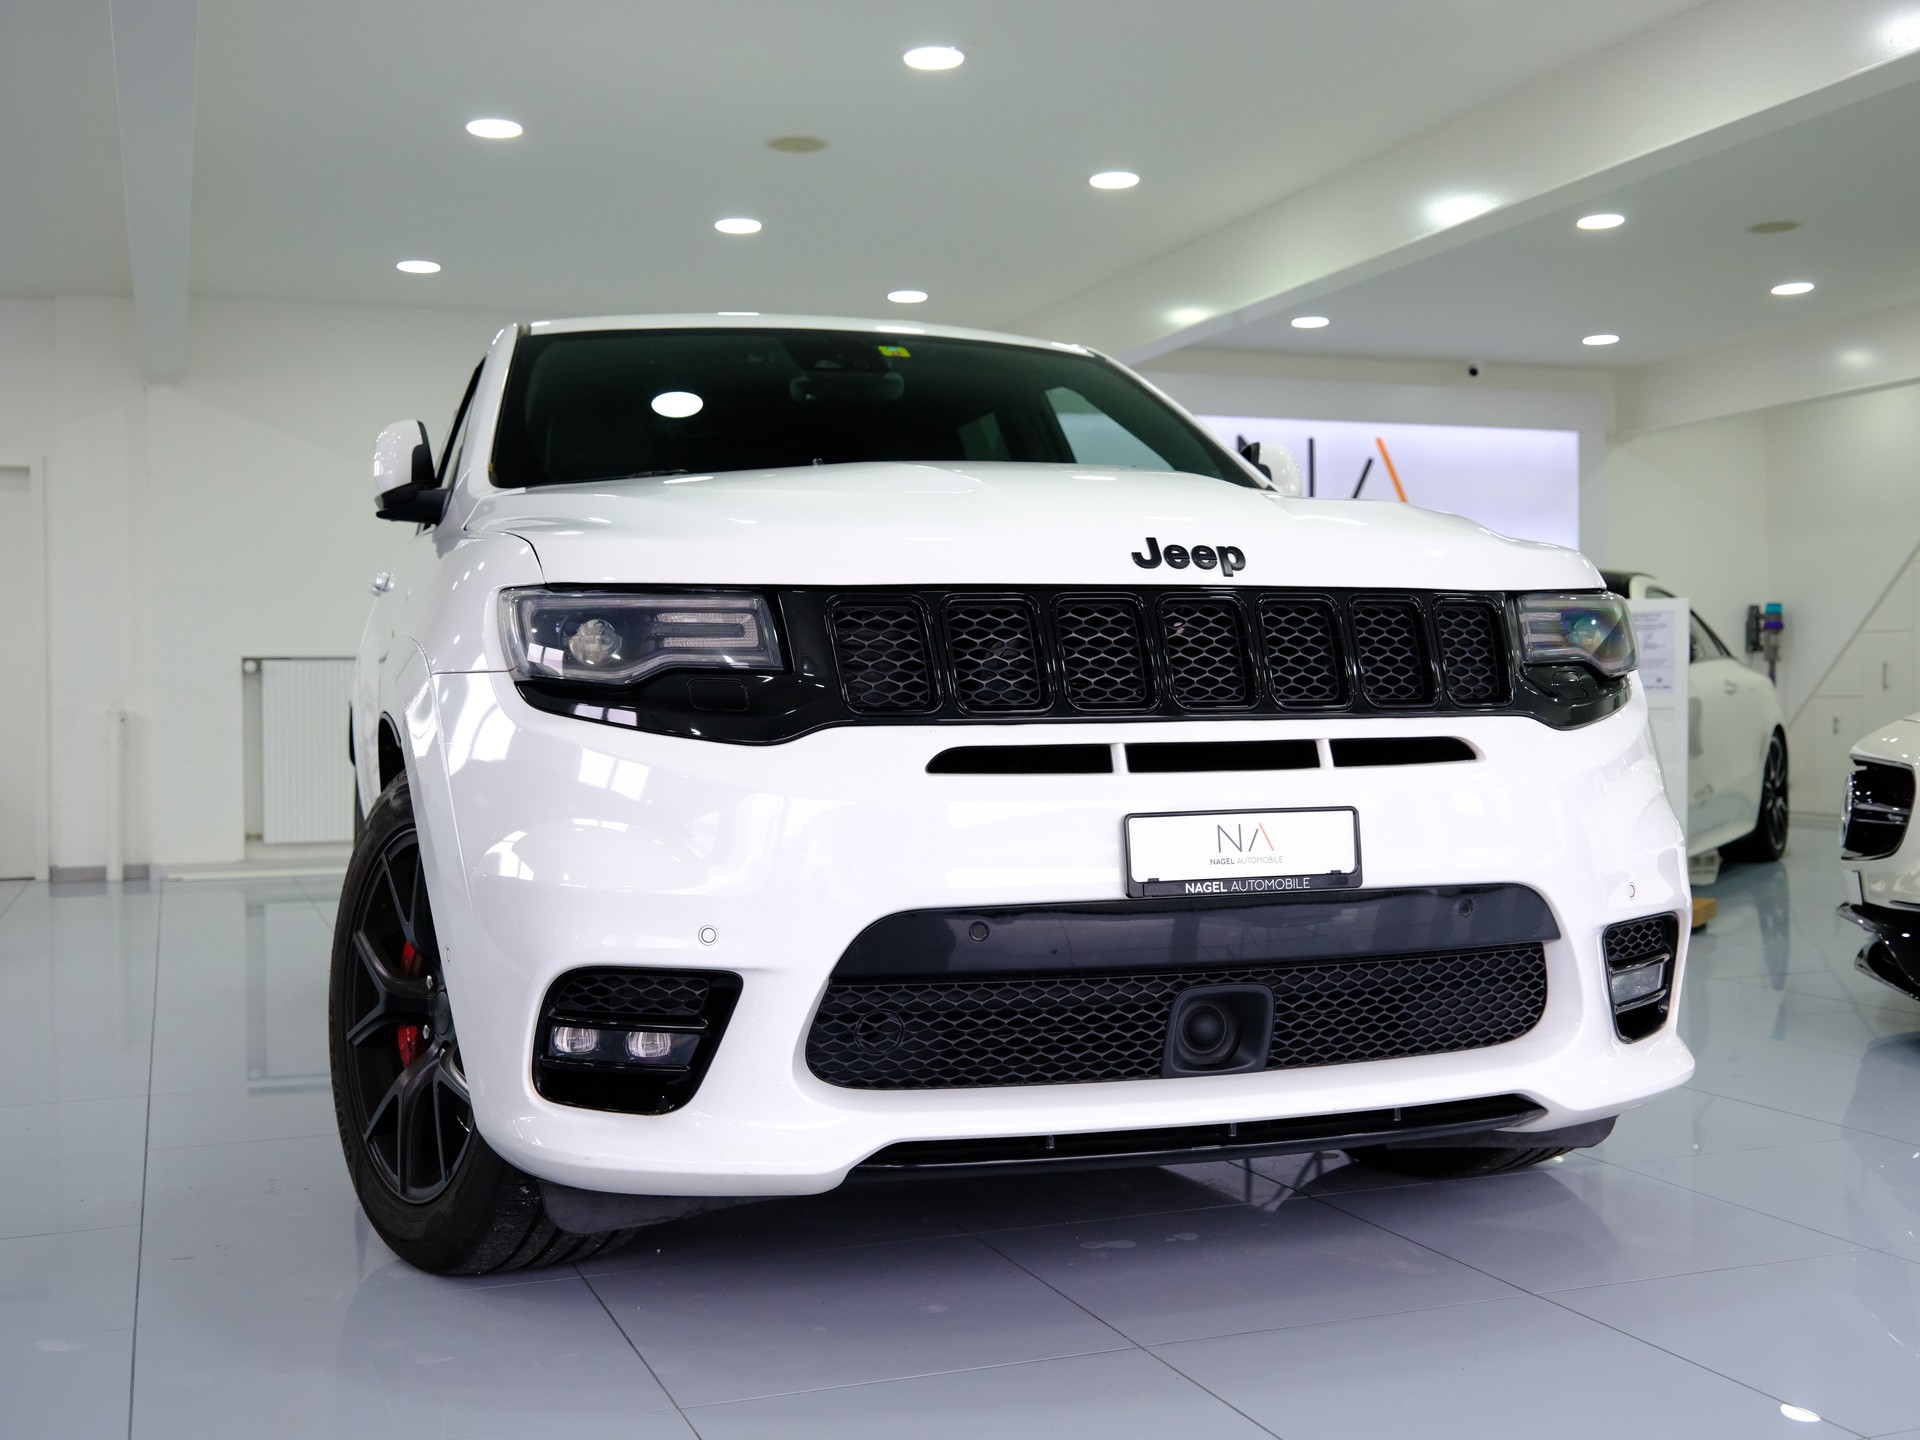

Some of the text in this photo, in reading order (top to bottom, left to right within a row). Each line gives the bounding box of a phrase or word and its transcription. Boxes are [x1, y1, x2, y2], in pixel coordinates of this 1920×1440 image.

[1131, 537, 1246, 577] Jeep
[1237, 856, 1283, 864] AUTOMOBILE
[1185, 878, 1310, 893] NAGEL AUTOMOBILE
